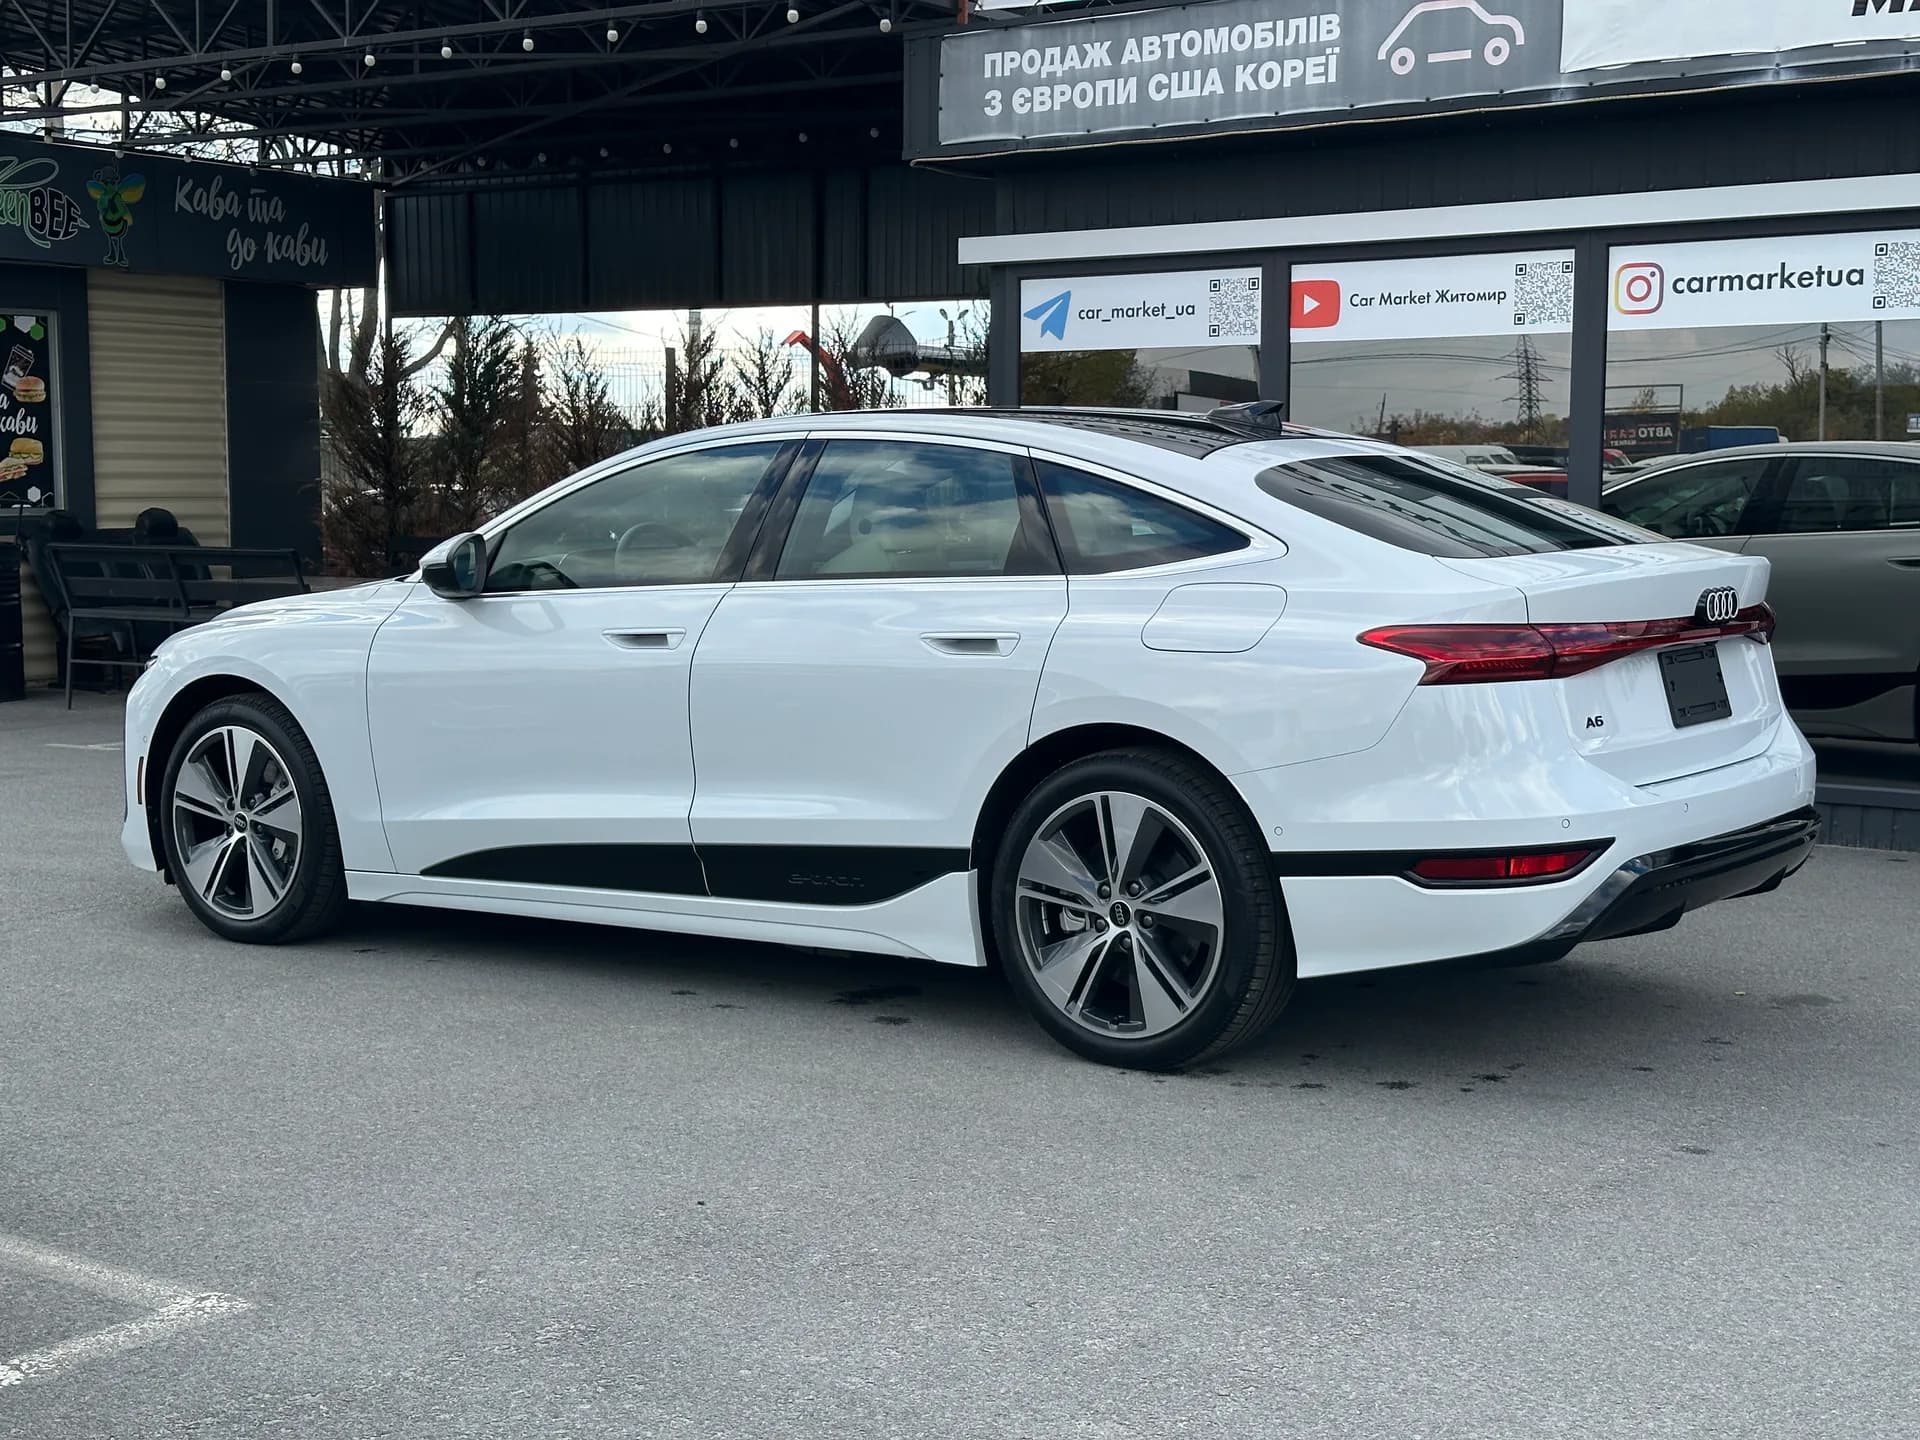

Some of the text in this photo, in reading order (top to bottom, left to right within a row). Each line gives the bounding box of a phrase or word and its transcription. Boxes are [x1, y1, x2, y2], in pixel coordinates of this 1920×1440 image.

[984, 13, 1341, 78] ПРОДАЖ АВТОМОБІЛІВ
[984, 47, 1340, 117] З ЄВРОПИ США КОРЕЇ
[174, 174, 242, 221] Кава
[227, 222, 329, 270] до кави
[1349, 287, 1508, 308] Car Market Житомир
[1671, 261, 1865, 295] carmarketua
[1077, 300, 1196, 322] car_market_ua
[1585, 715, 1604, 729] A6
